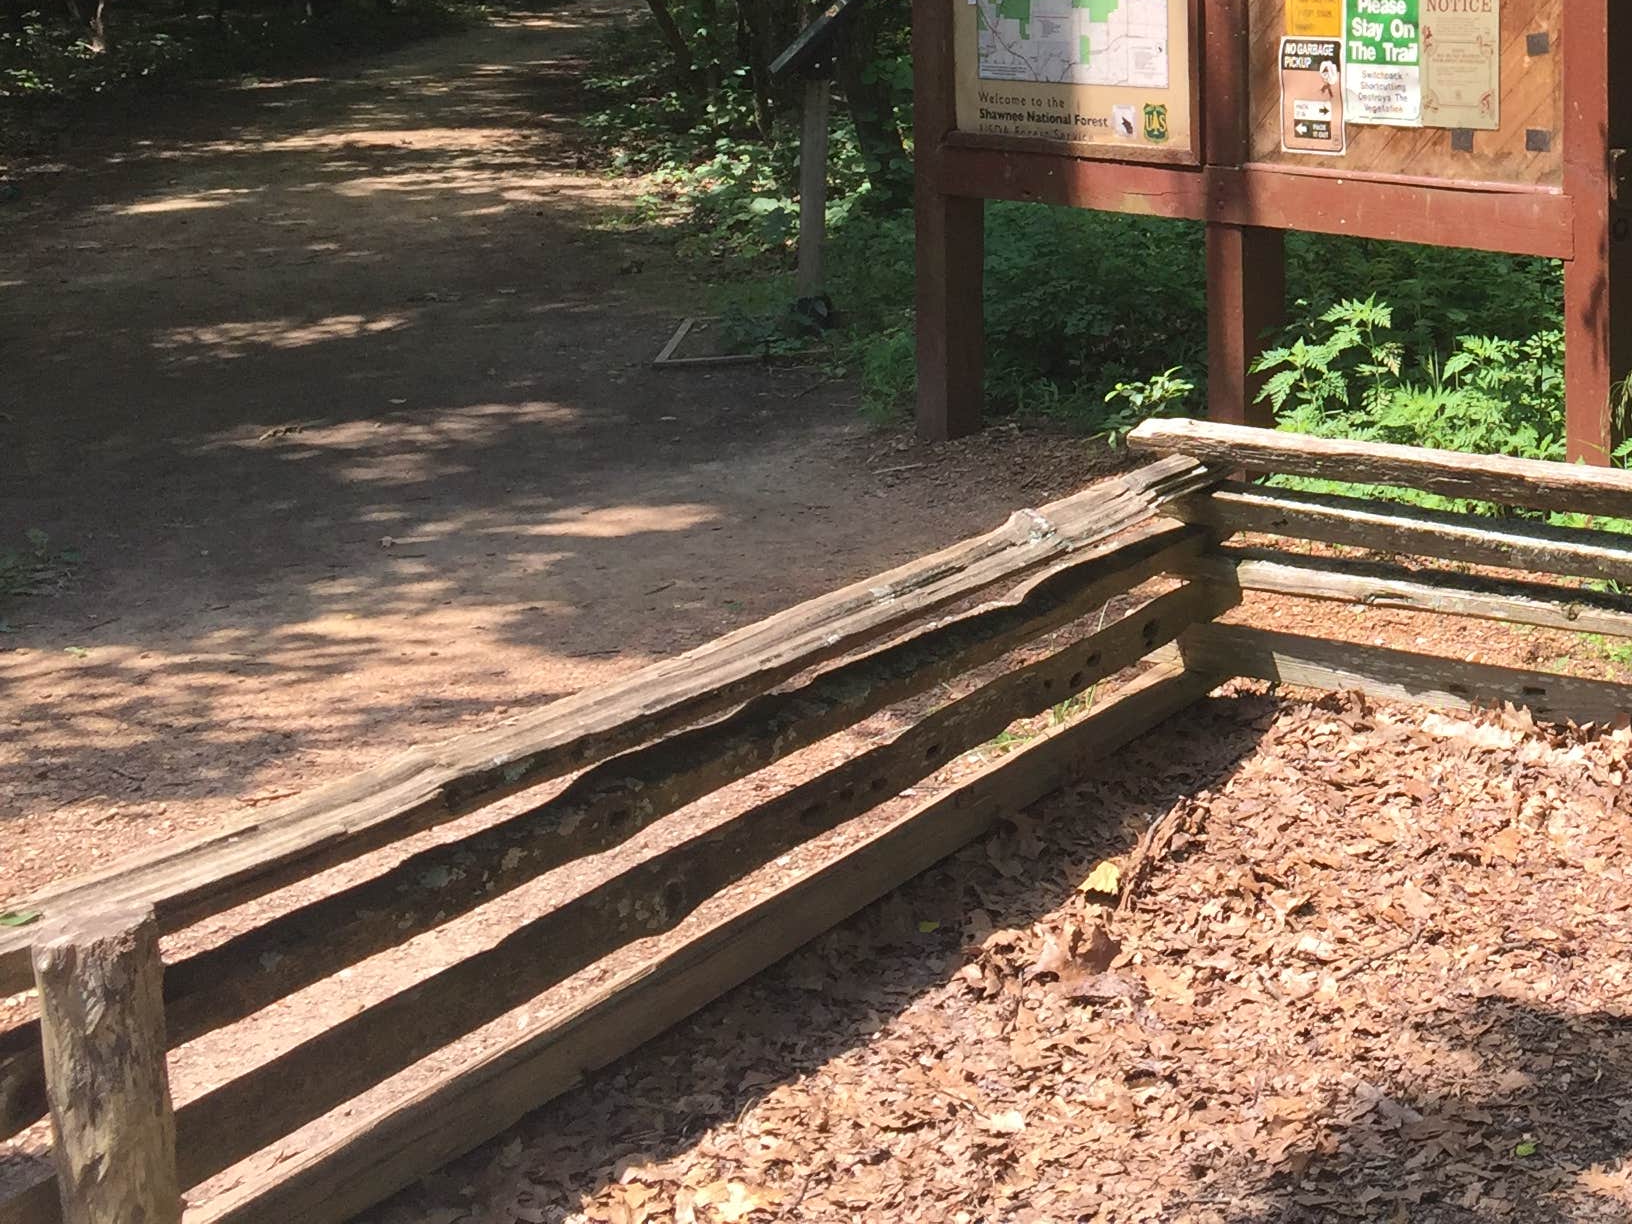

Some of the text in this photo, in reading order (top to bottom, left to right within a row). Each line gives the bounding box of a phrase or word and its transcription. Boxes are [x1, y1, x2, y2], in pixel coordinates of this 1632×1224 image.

[1351, 16, 1384, 41] Stay
[1390, 18, 1415, 39] On
[1284, 42, 1335, 56] NO GARBAGE
[1348, 41, 1418, 63] The Trail
[1284, 56, 1312, 69] PICKUP
[978, 92, 1065, 109] Welcome to the
[979, 108, 1109, 127] Shawnee National Forest
